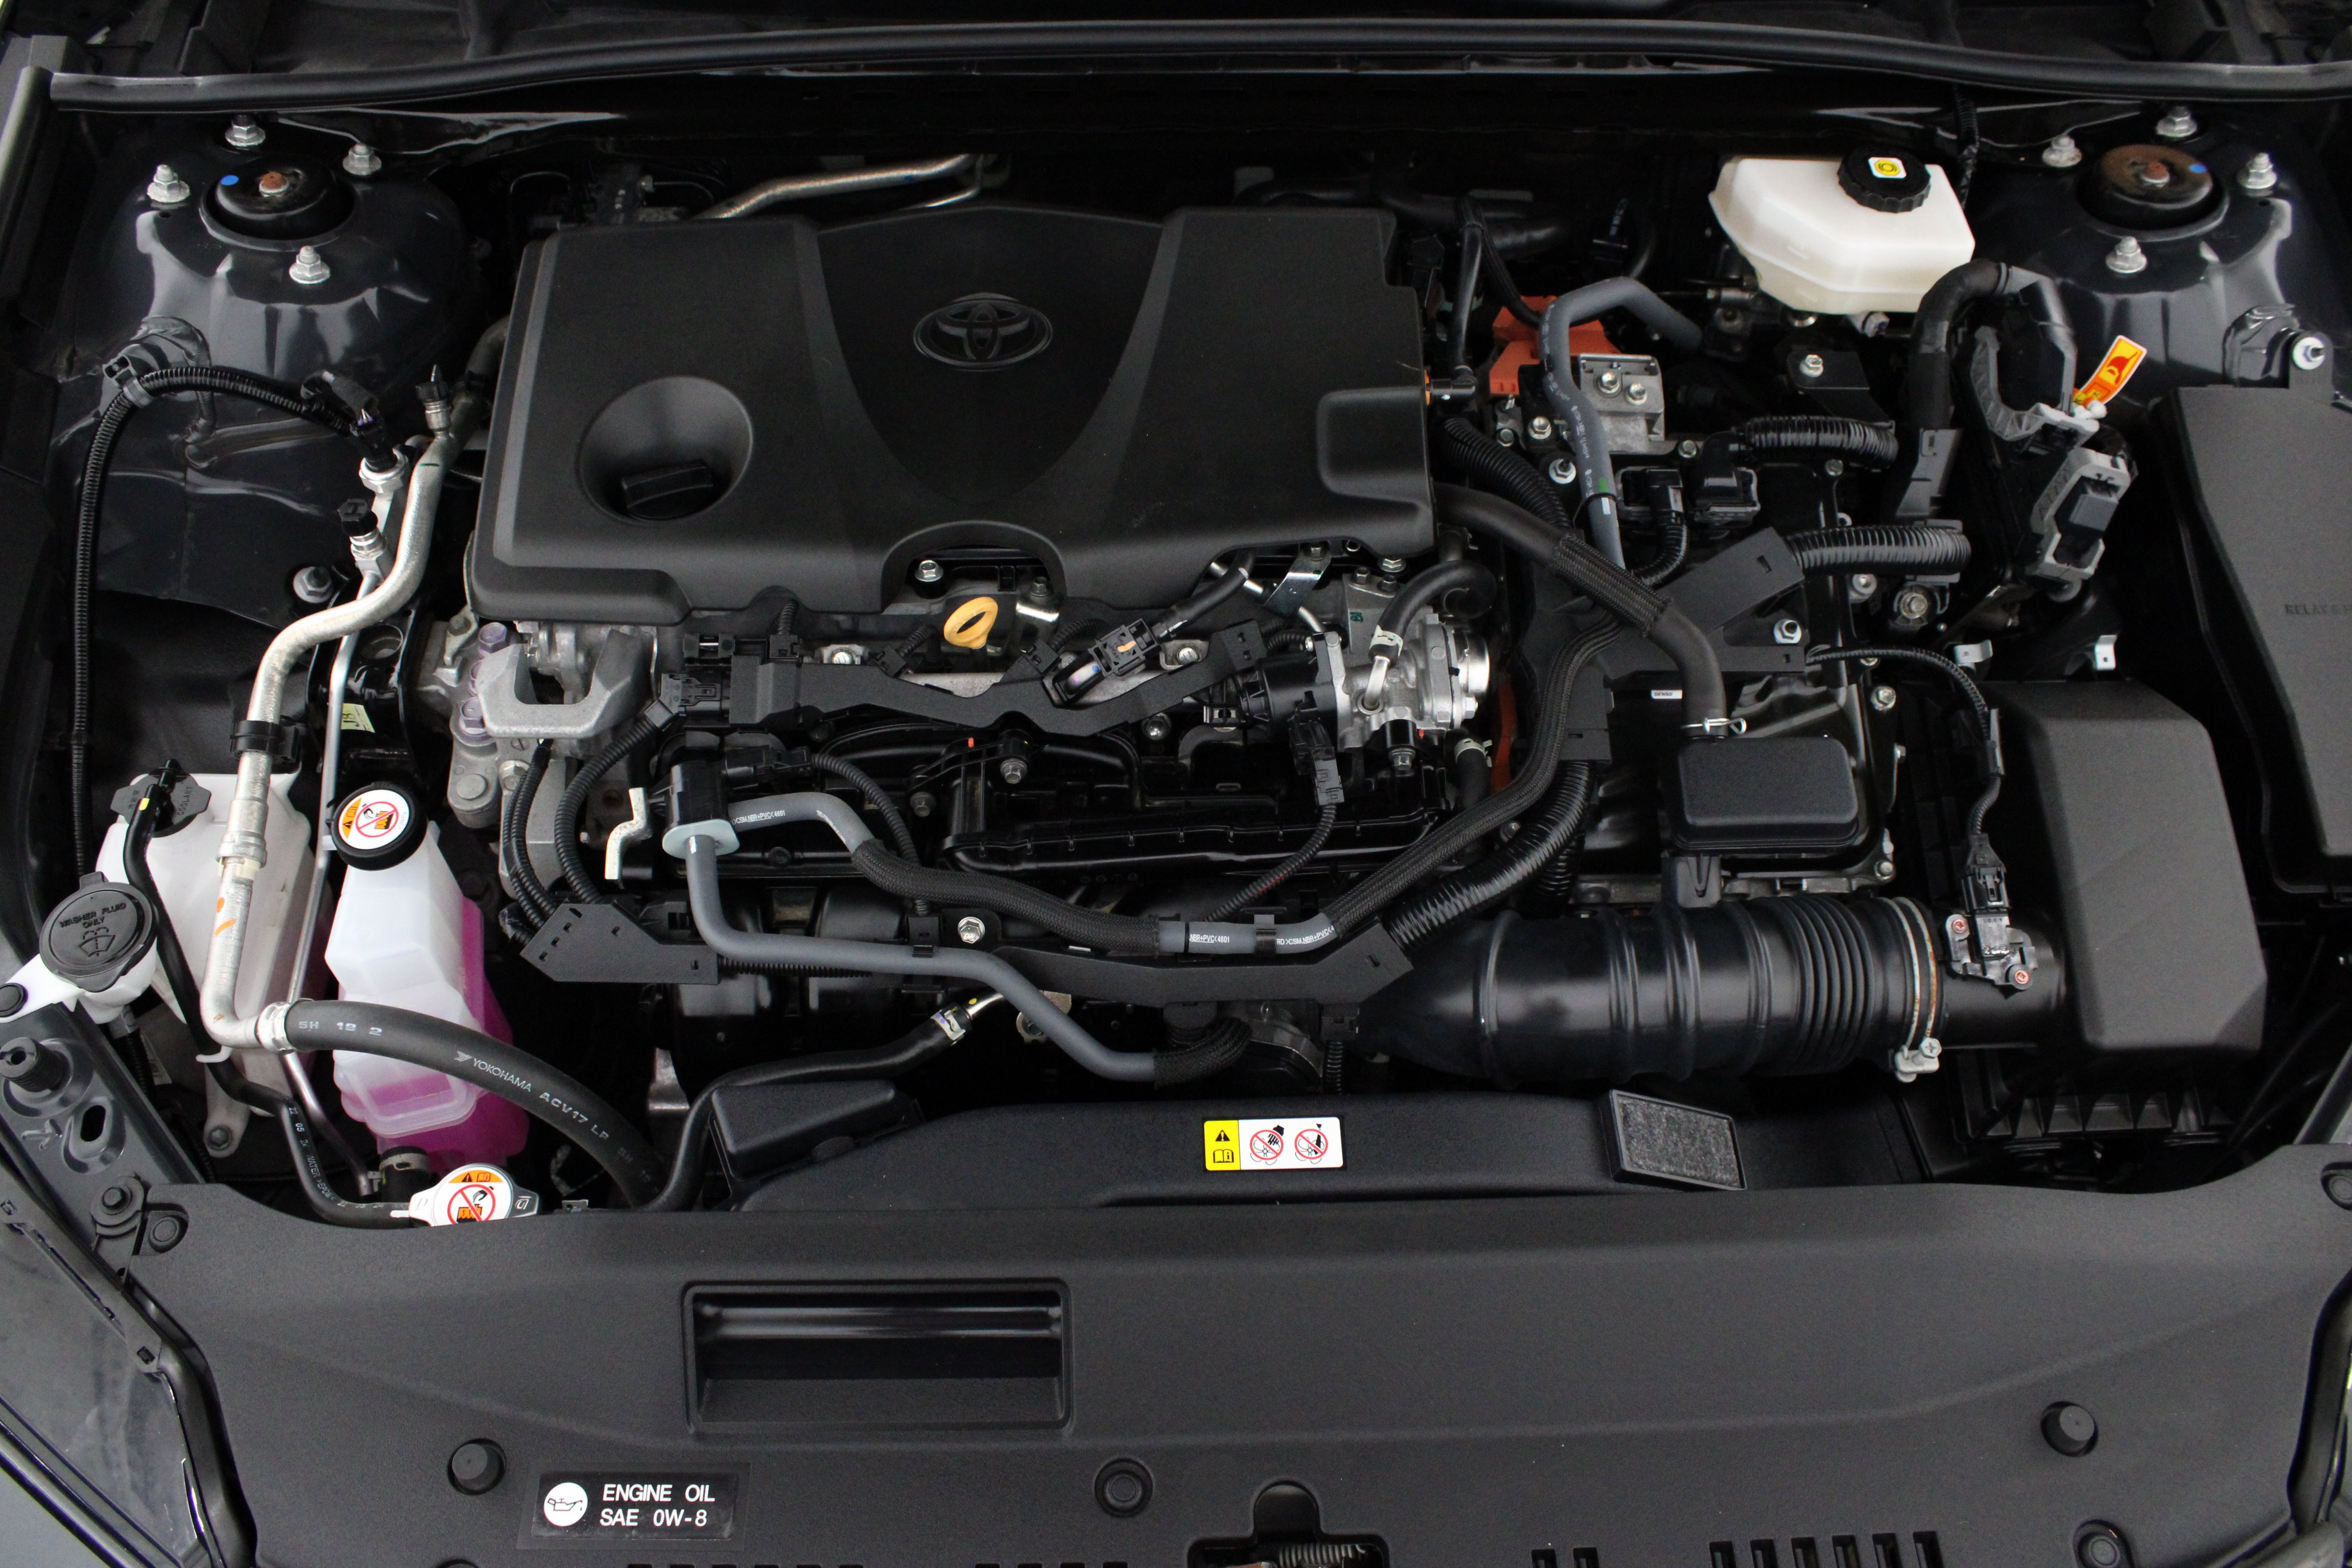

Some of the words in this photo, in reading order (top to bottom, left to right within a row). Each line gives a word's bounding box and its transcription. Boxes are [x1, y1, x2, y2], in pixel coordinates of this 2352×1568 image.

[178, 786, 193, 816] COOLANT
[60, 911, 97, 928] WASHER
[102, 902, 127, 915] FLUID
[82, 916, 105, 928] ONLY
[369, 1027, 383, 1036] 2
[473, 1058, 532, 1092] YOKOHAMA
[539, 1092, 588, 1123] ACV17
[590, 1124, 610, 1140] LP
[602, 1483, 673, 1502] ENGINE
[685, 1484, 715, 1502] OIL
[600, 1508, 639, 1527] SAE
[653, 1508, 707, 1527] 0W-8
